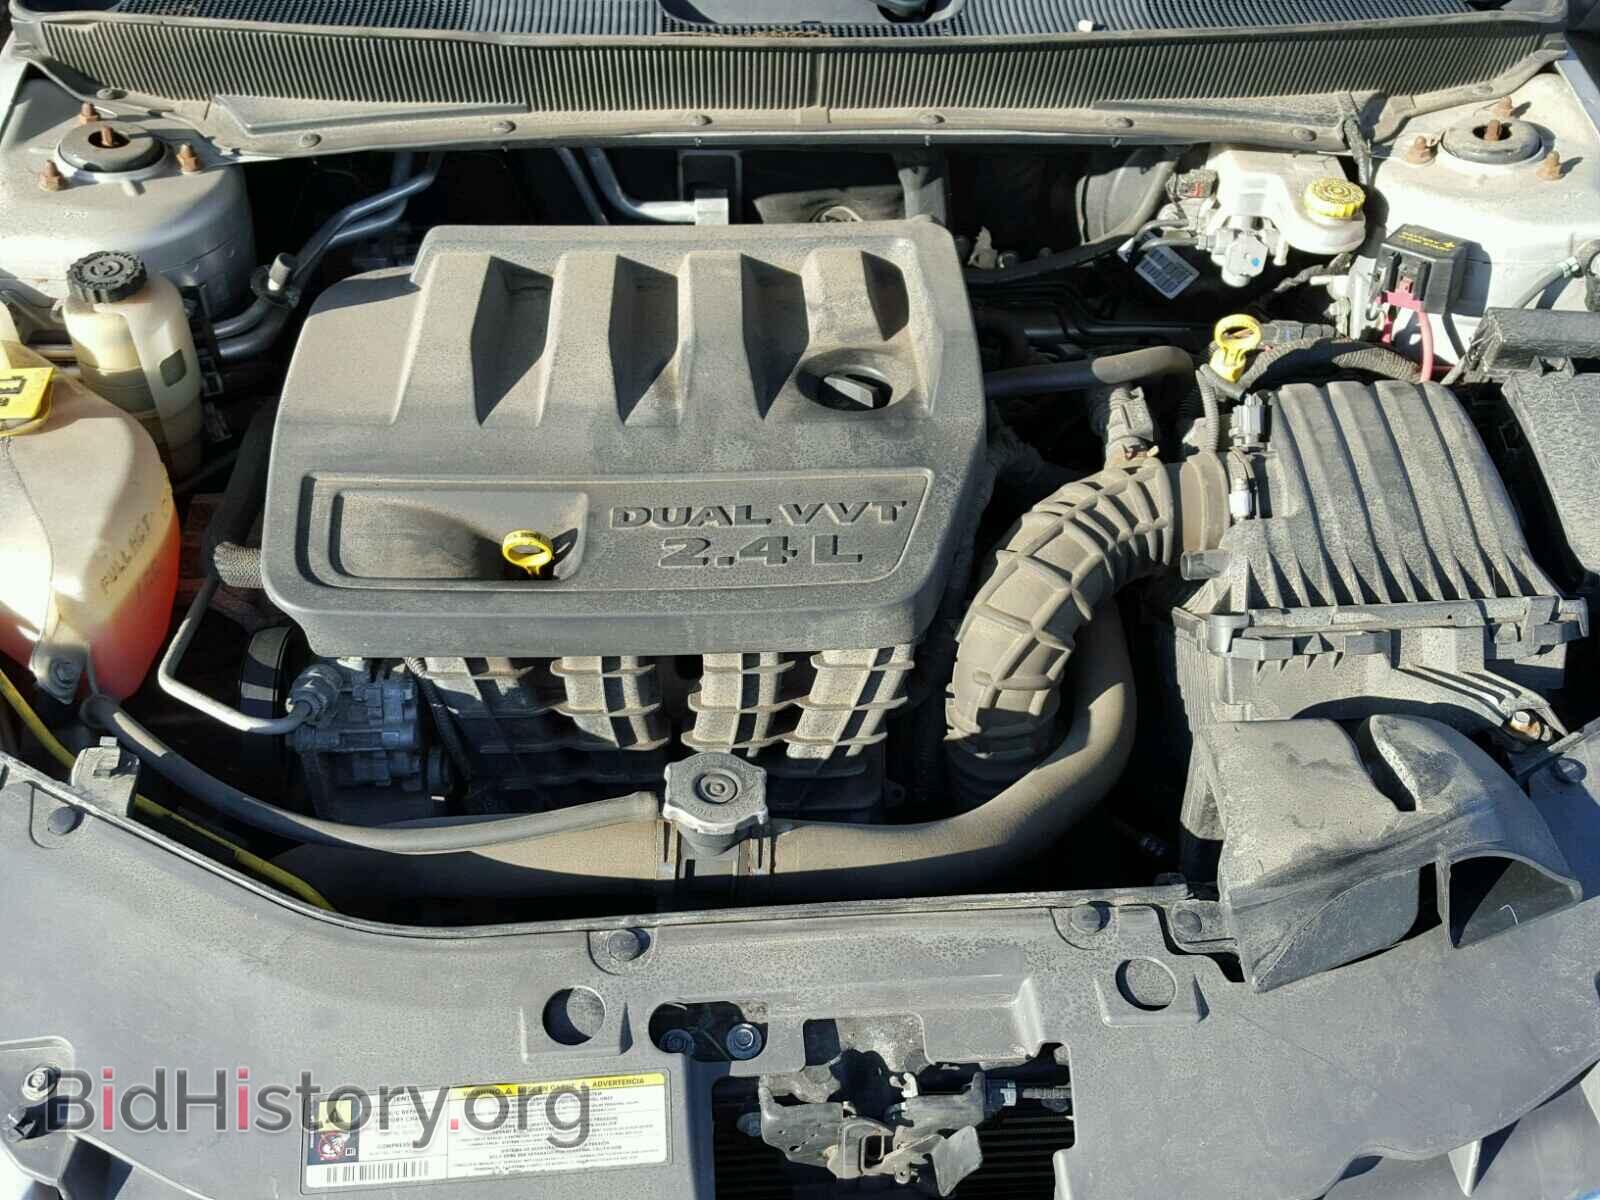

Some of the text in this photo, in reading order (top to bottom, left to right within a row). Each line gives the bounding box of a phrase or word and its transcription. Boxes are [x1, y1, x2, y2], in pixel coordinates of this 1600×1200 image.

[610, 500, 906, 528] DUAL VVT
[591, 1077, 646, 1088] ADVERTENCIA
